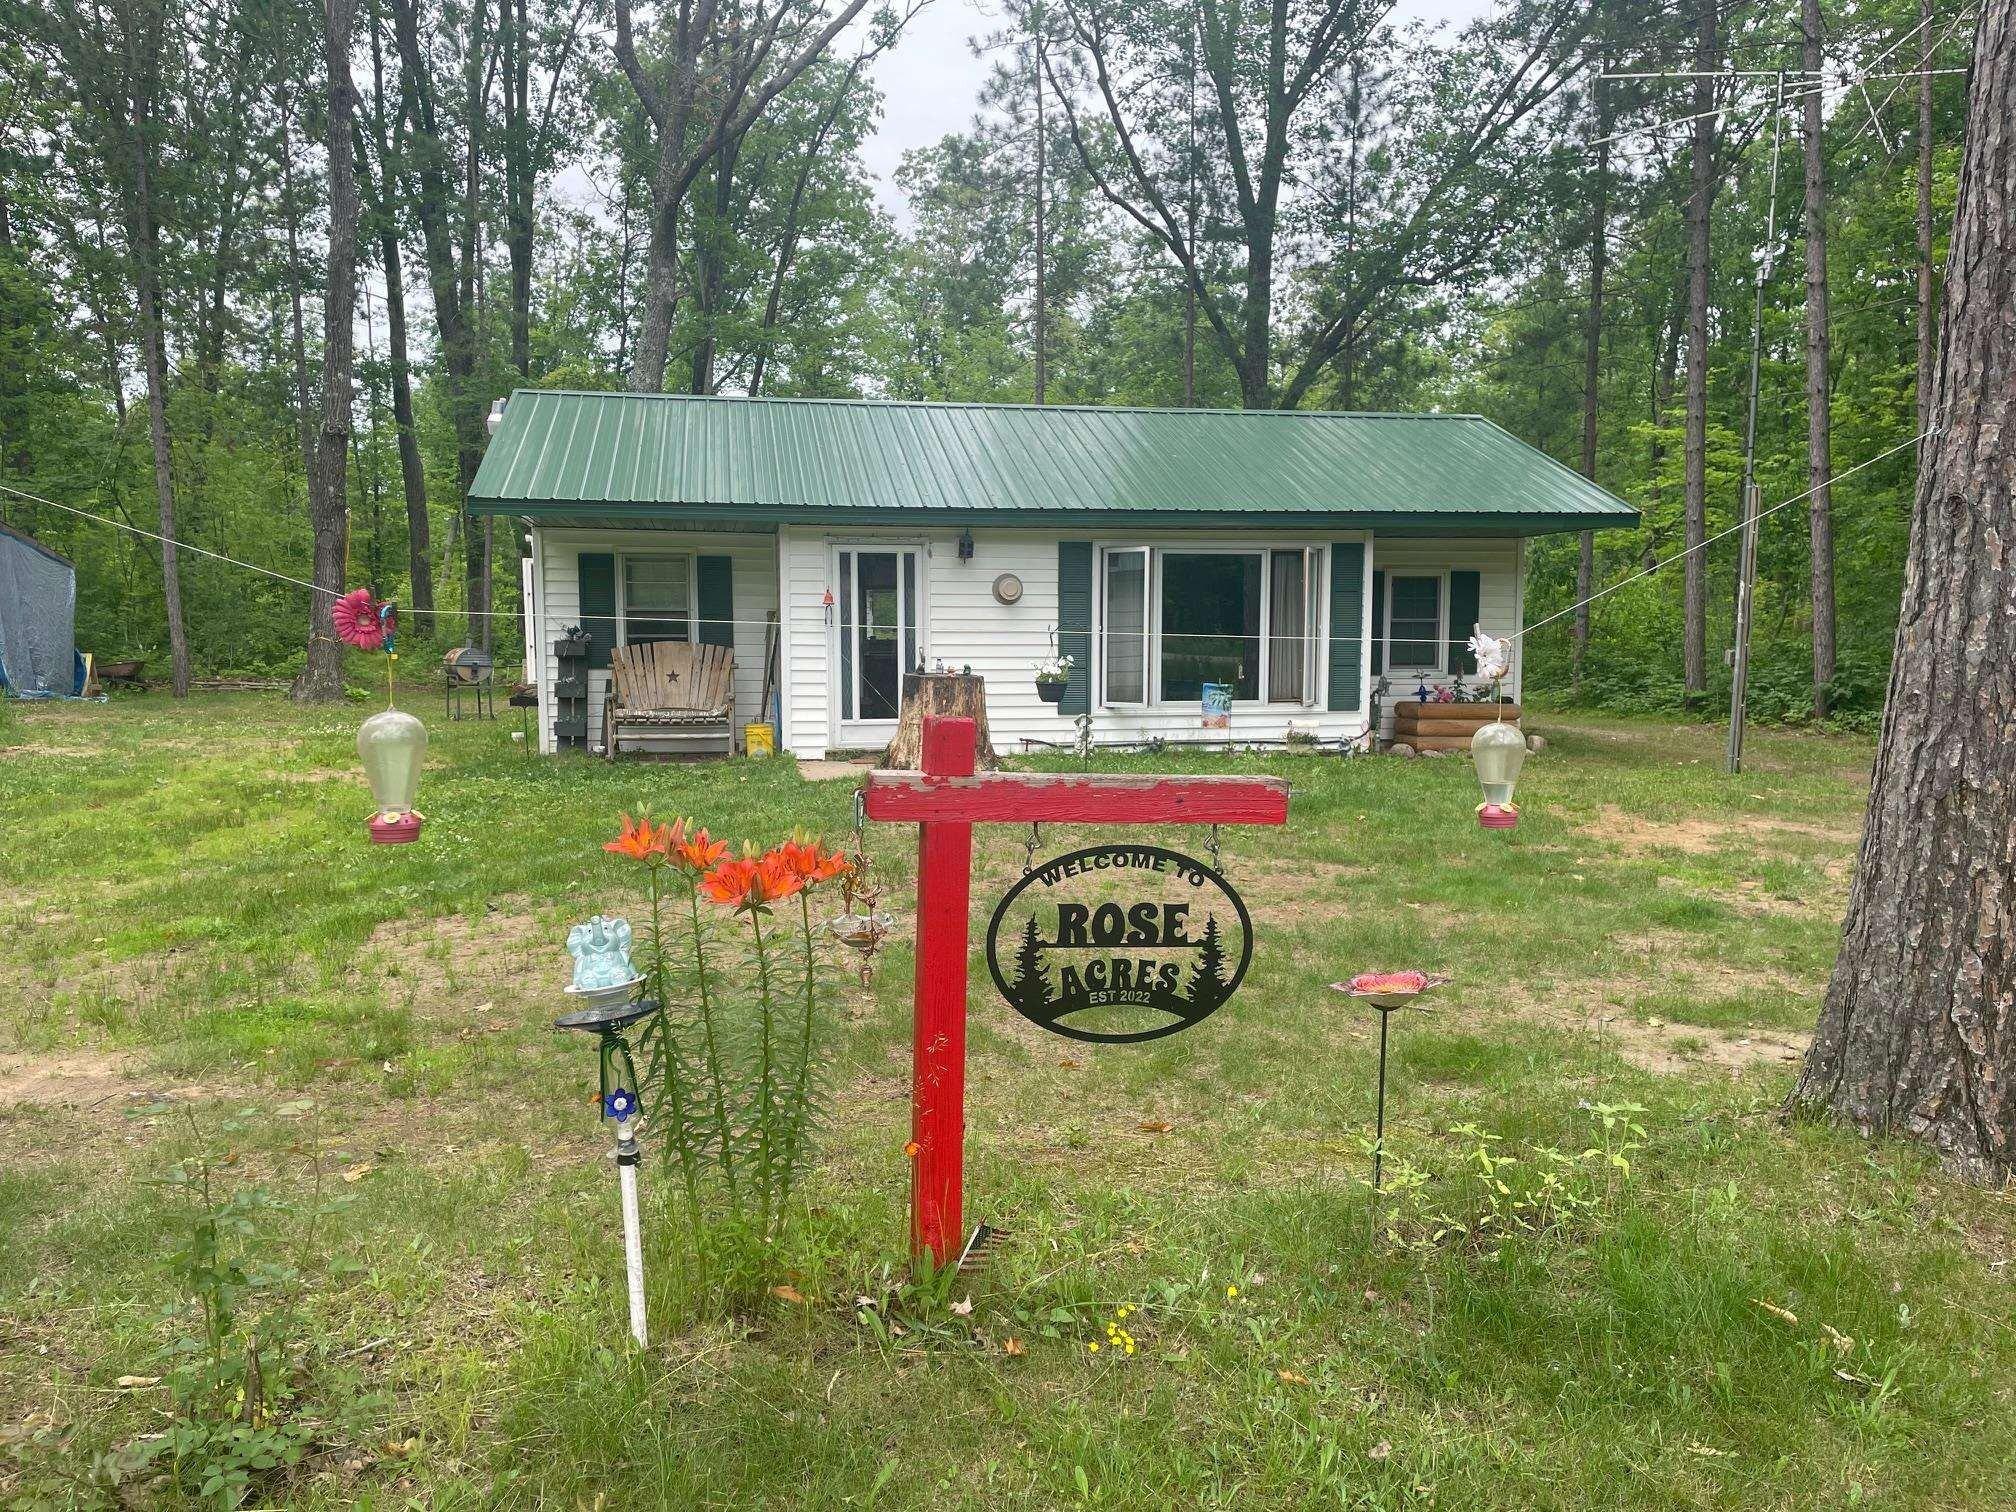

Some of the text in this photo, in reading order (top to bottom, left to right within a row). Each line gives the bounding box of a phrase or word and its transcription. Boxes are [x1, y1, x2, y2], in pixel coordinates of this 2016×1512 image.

[1039, 853, 1205, 888] WELCOME TO
[1057, 902, 1190, 945] ROSE
[1060, 959, 1181, 1000] ACRES
[1089, 990, 1151, 1004] EST 2022
